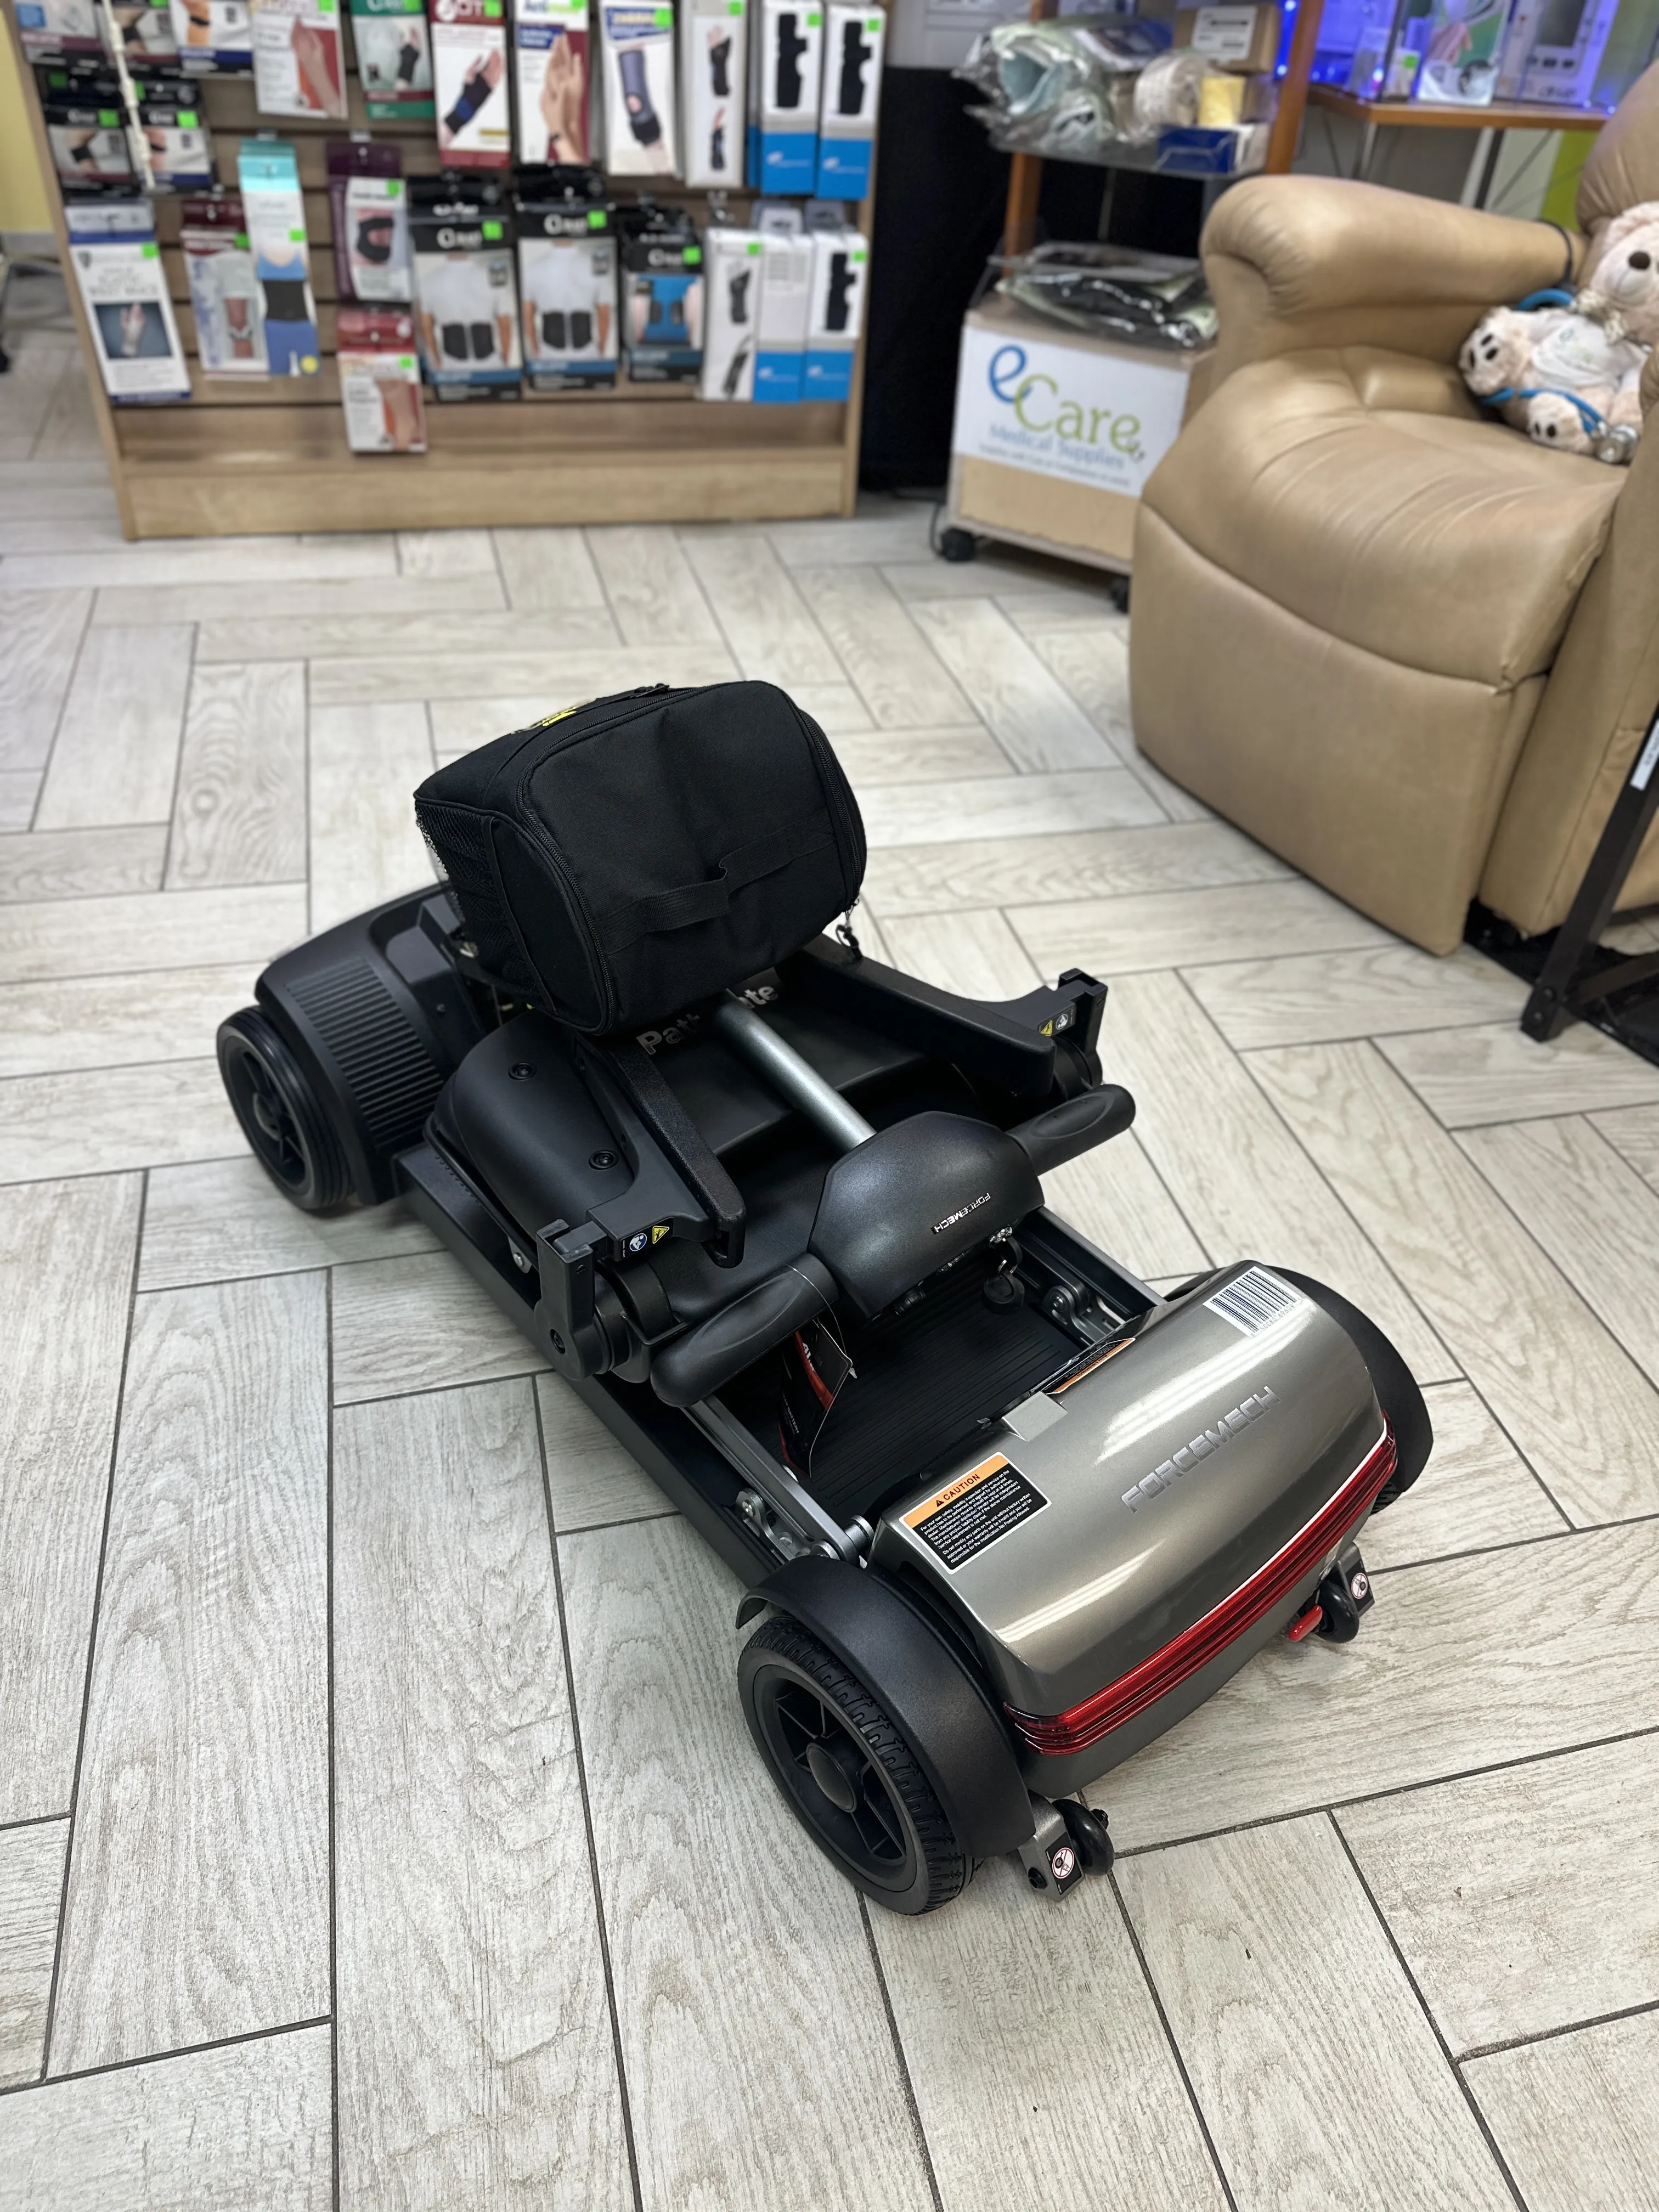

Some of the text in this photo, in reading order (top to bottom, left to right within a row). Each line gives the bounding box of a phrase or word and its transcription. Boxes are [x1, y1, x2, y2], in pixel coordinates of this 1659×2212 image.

[987, 345, 1142, 454] eCare
[934, 1192, 991, 1233] FORCEMECH
[943, 1474, 980, 1500] CAUTION
[1121, 1385, 1281, 1514] FORCEMECH
